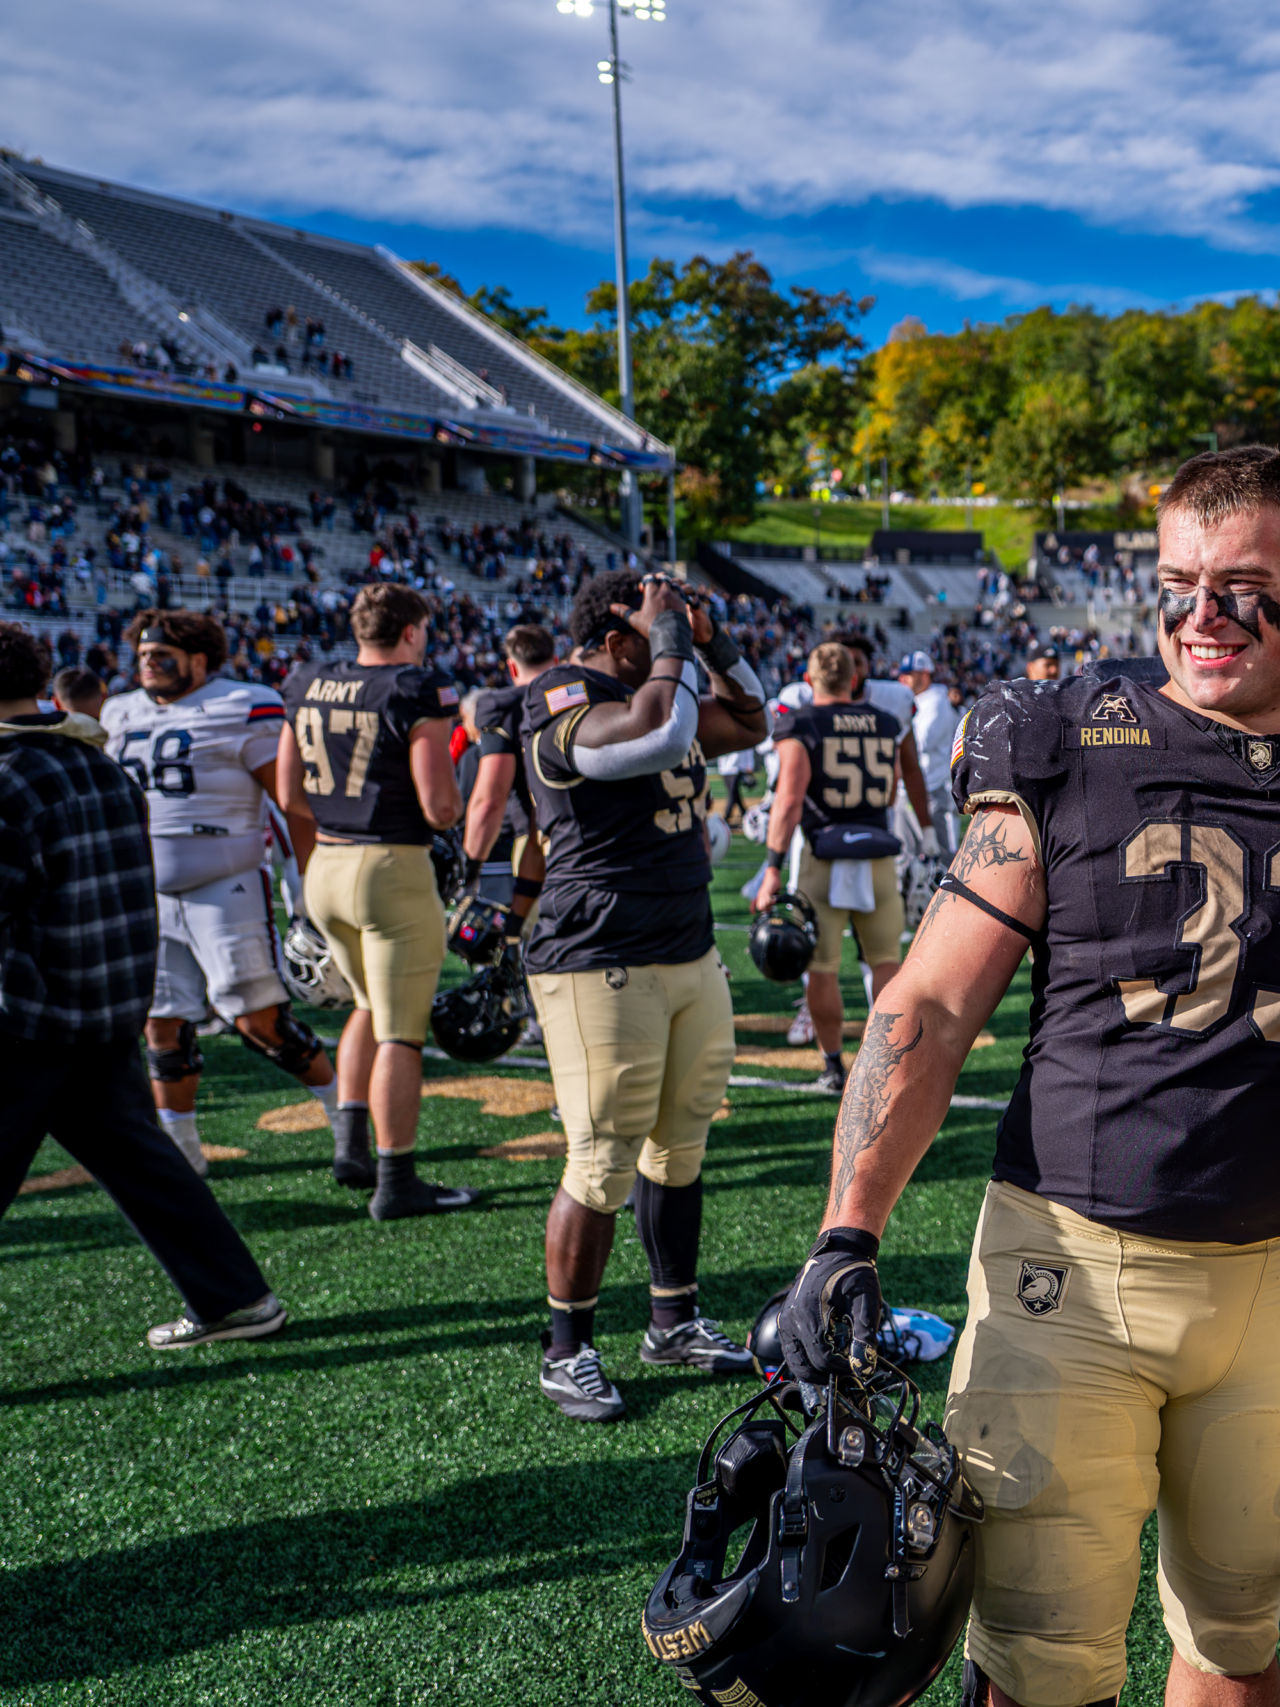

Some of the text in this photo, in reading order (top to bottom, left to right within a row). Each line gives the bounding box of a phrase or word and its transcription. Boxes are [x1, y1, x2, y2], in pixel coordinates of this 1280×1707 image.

[305, 677, 364, 703] ARMY
[833, 713, 877, 733] ARMY
[1079, 726, 1152, 746] RENDINA
[119, 729, 196, 799] 58
[295, 706, 380, 798] 97
[822, 736, 895, 809] 55
[655, 1619, 715, 1660] WEST
[718, 1684, 745, 1701] RANGER
